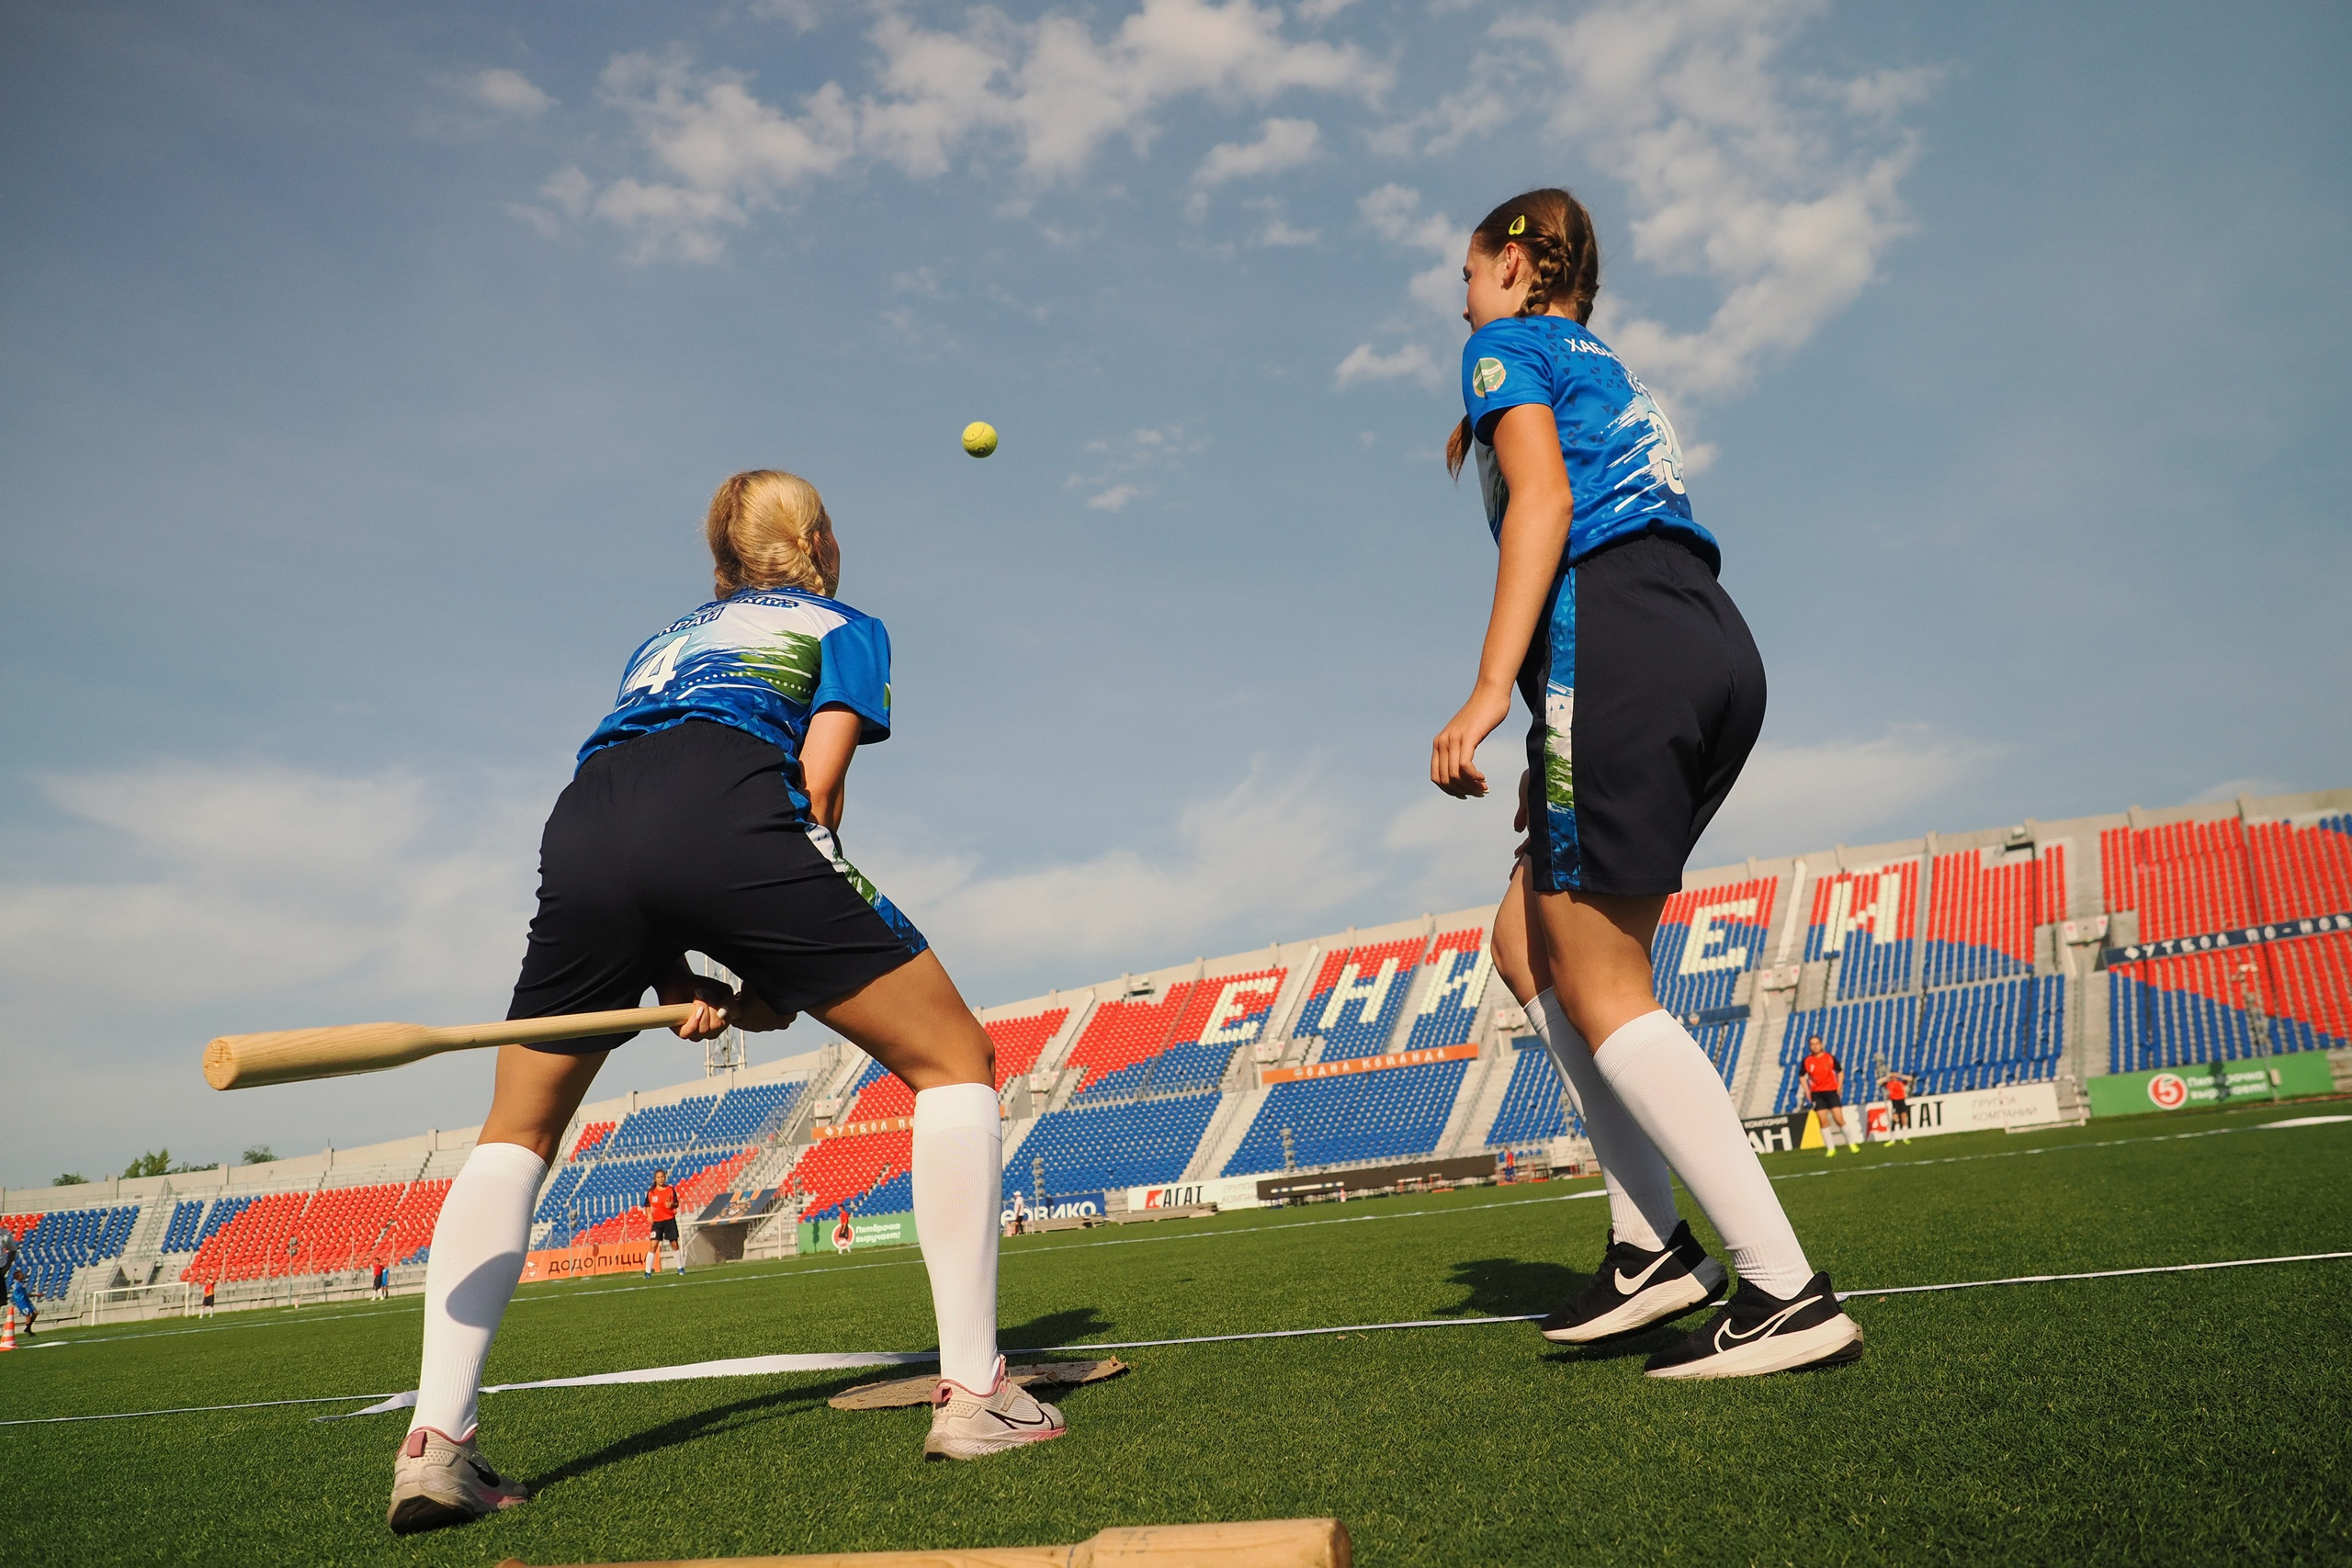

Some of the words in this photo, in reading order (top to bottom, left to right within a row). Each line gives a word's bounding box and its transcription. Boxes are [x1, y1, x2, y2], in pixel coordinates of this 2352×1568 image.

[634, 632, 693, 694] 4
[2124, 933, 2230, 961] ФУТБОЛ
[1306, 1063, 1351, 1077] ОДНА
[1362, 1048, 1446, 1069] КОМАНДА
[2158, 1075, 2179, 1102] 5
[824, 1122, 888, 1137] ФУТБОЛ
[1163, 1185, 1204, 1208] АГАТ
[548, 1258, 594, 1275] ДОДО
[597, 1251, 648, 1268] ПИЦЦ
